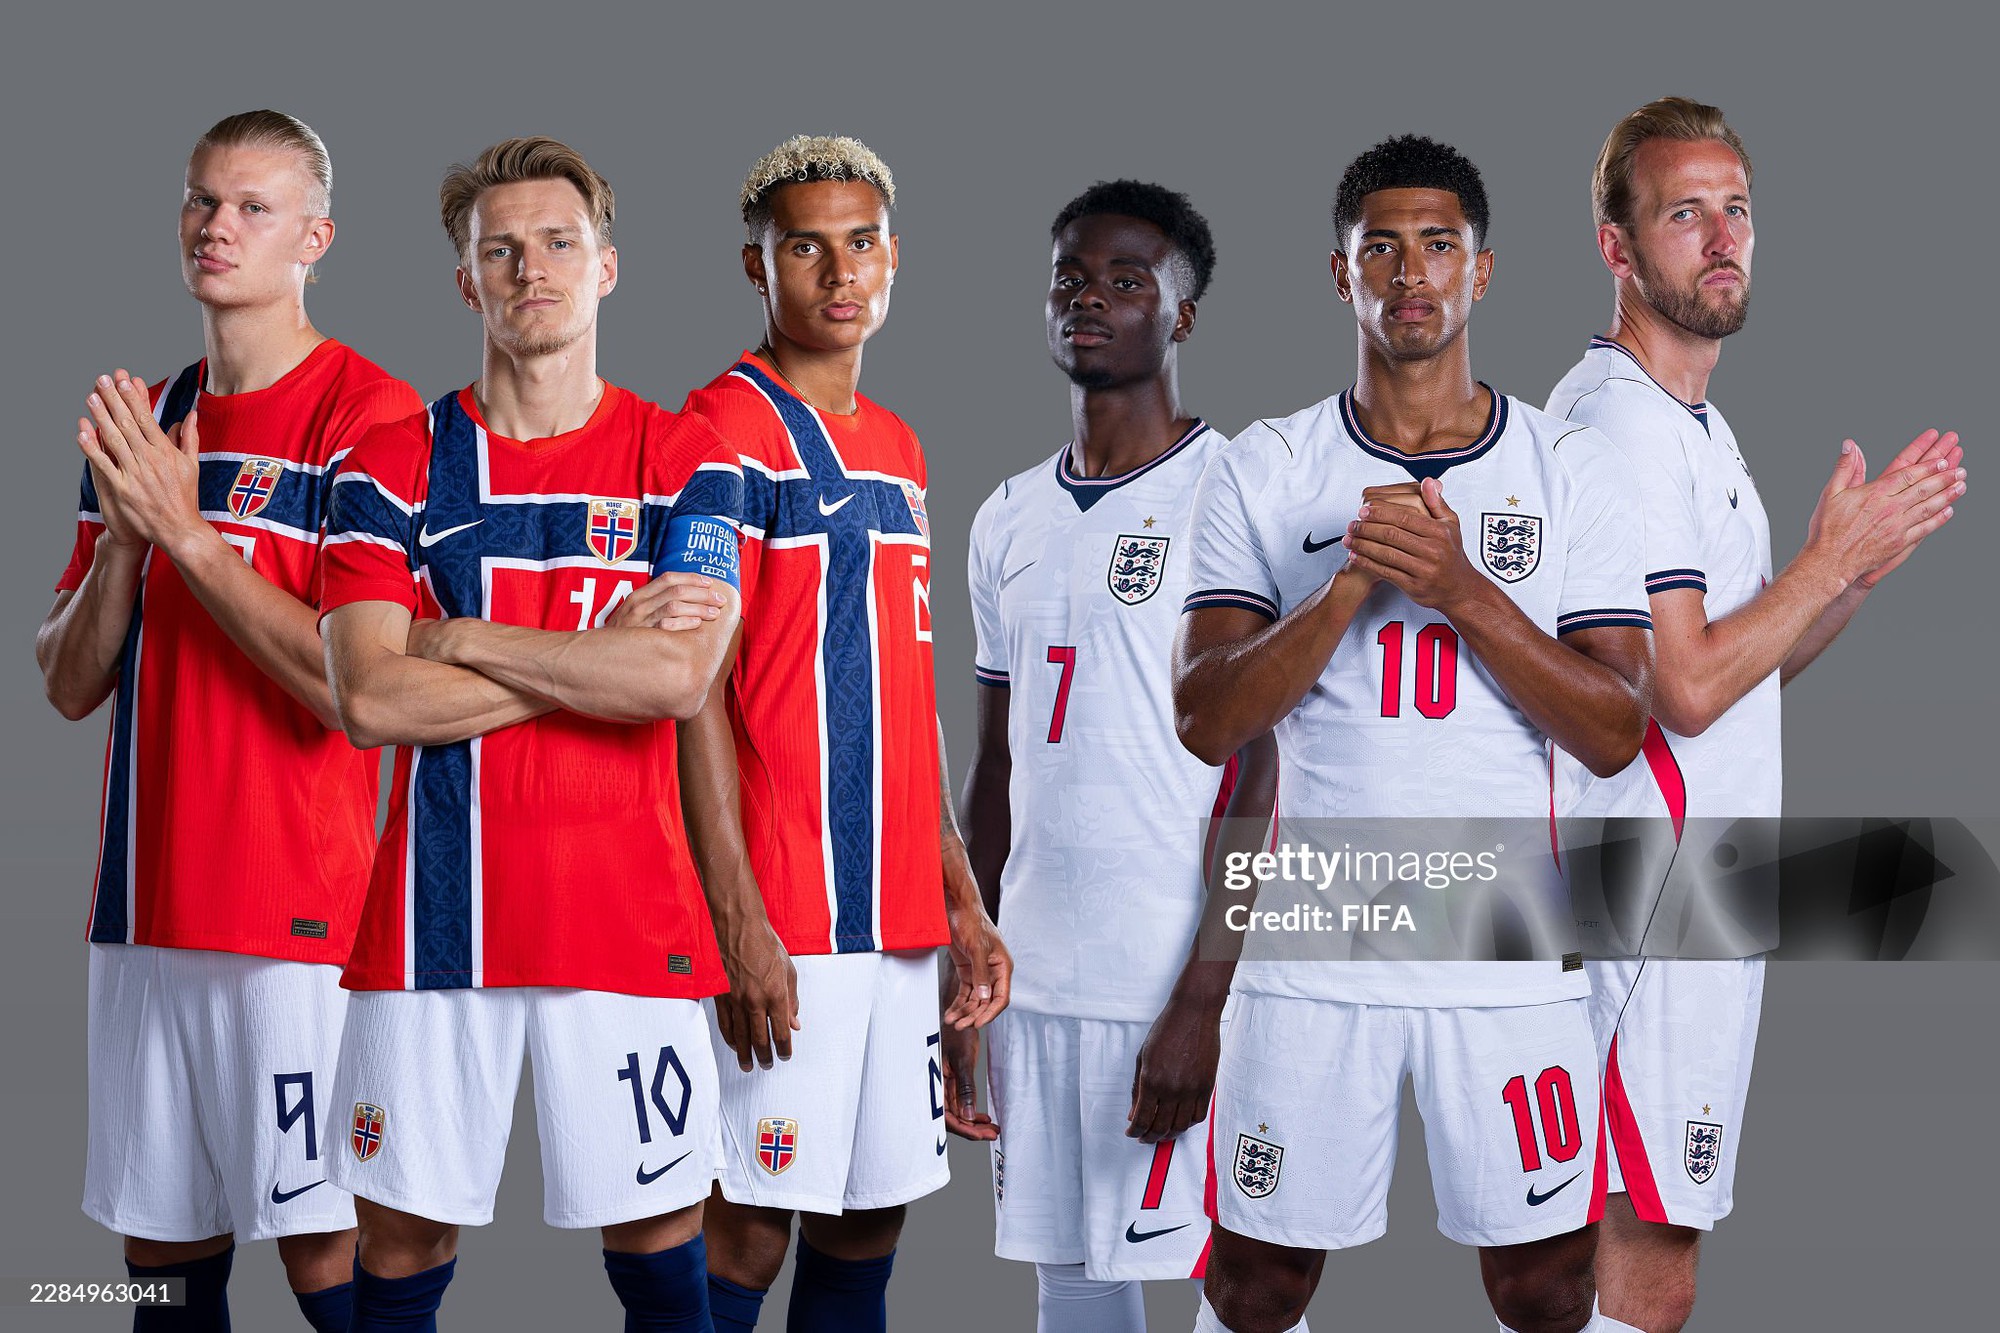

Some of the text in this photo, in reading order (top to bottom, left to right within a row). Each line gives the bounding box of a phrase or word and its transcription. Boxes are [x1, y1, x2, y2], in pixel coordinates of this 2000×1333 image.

[681, 549, 706, 563] the
[687, 533, 736, 563] UNITES
[690, 521, 736, 546] FOOTBALL
[702, 566, 726, 578] FIFA
[1046, 645, 1077, 744] 7
[1377, 620, 1459, 720] 10
[273, 1071, 318, 1161] 9
[617, 1045, 693, 1145] 10
[1502, 1065, 1583, 1174] 10
